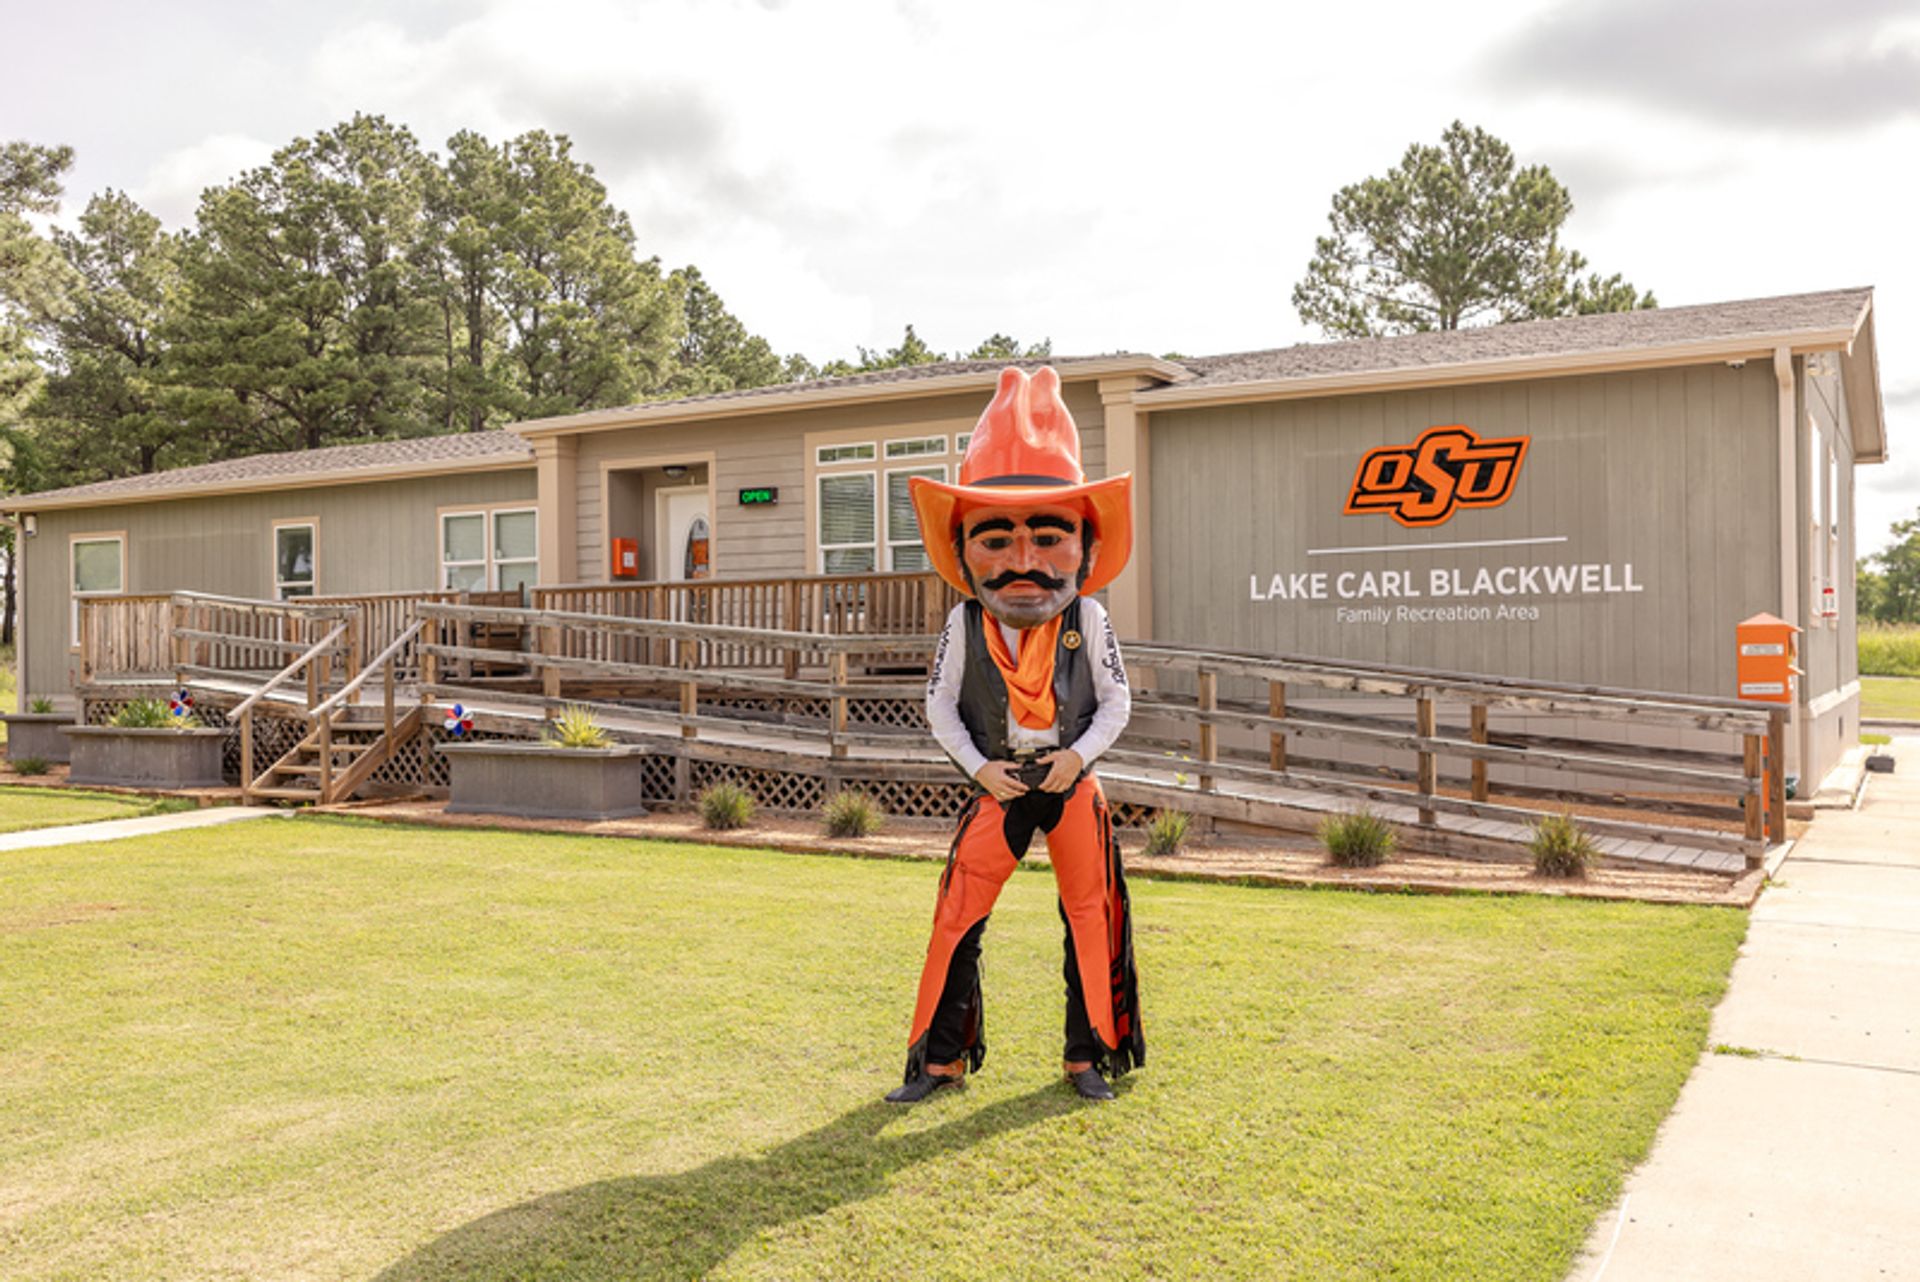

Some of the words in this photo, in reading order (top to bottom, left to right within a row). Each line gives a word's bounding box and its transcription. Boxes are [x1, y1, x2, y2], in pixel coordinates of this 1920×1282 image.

[1347, 427, 1527, 525] OSU
[741, 491, 770, 503] OPEN
[1250, 573, 1328, 600] LAKE
[1336, 570, 1420, 599] CARL
[1430, 563, 1644, 597] BLACKWELL
[1336, 606, 1391, 625] Family
[1397, 604, 1491, 623] Recreation
[1495, 603, 1540, 621] Area
